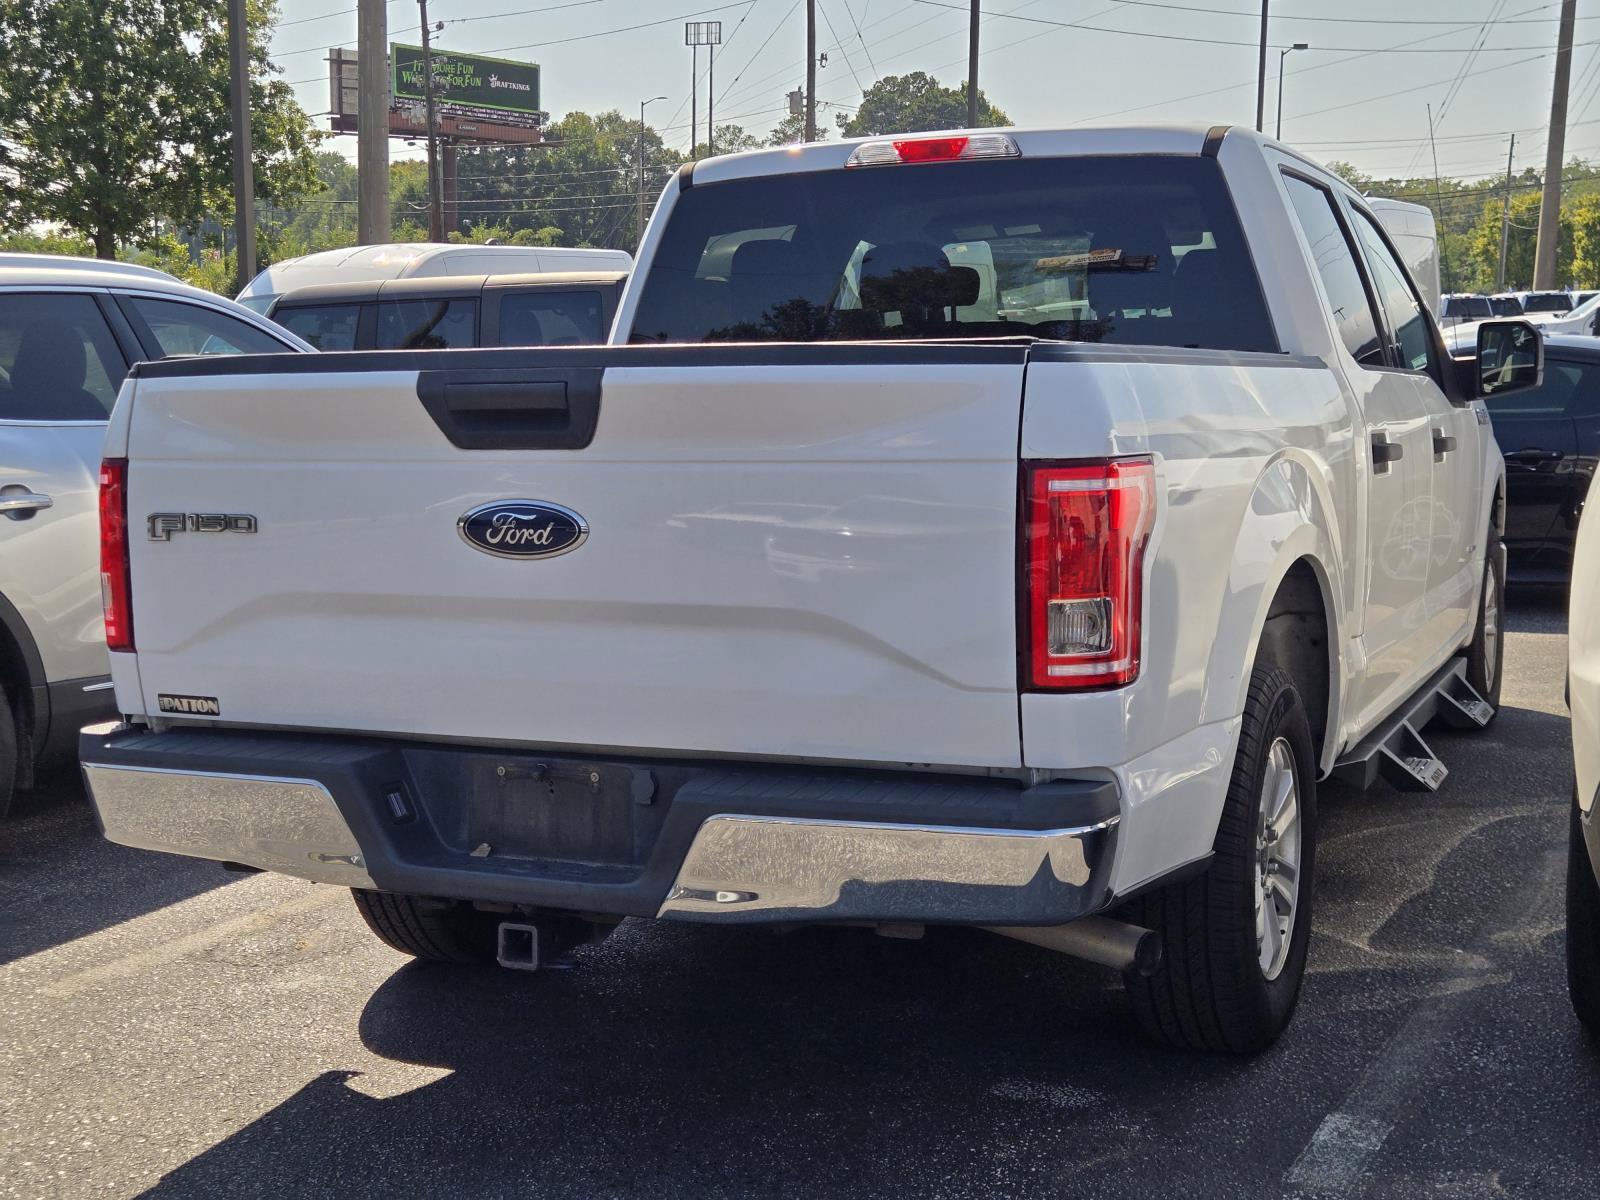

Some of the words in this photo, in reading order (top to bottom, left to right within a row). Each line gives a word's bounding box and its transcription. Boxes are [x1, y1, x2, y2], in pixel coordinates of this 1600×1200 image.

[457, 62, 475, 74] FUN
[448, 74, 464, 87] FOR
[465, 75, 482, 86] FUN
[490, 80, 530, 91] DRAFTKINGS
[486, 512, 554, 545] Ford
[163, 697, 219, 713] PATTON
